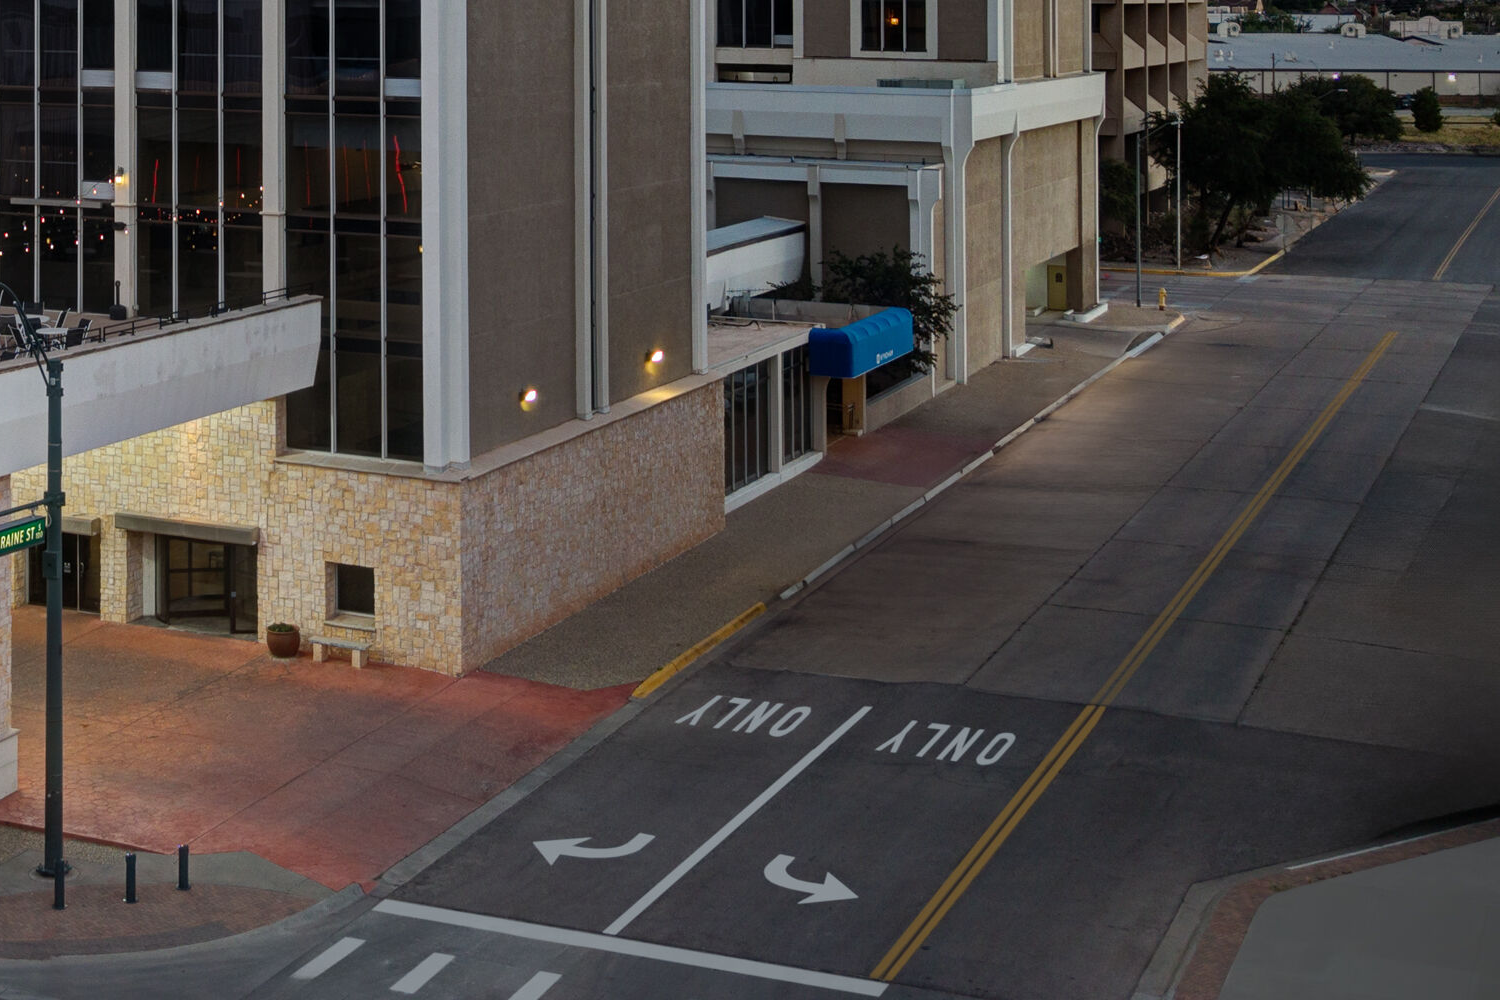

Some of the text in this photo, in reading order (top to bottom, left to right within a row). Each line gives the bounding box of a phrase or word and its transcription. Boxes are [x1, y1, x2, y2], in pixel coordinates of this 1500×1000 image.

[25, 526, 35, 541] ST
[675, 694, 812, 738] ONLY
[875, 719, 1016, 766] ONLY
